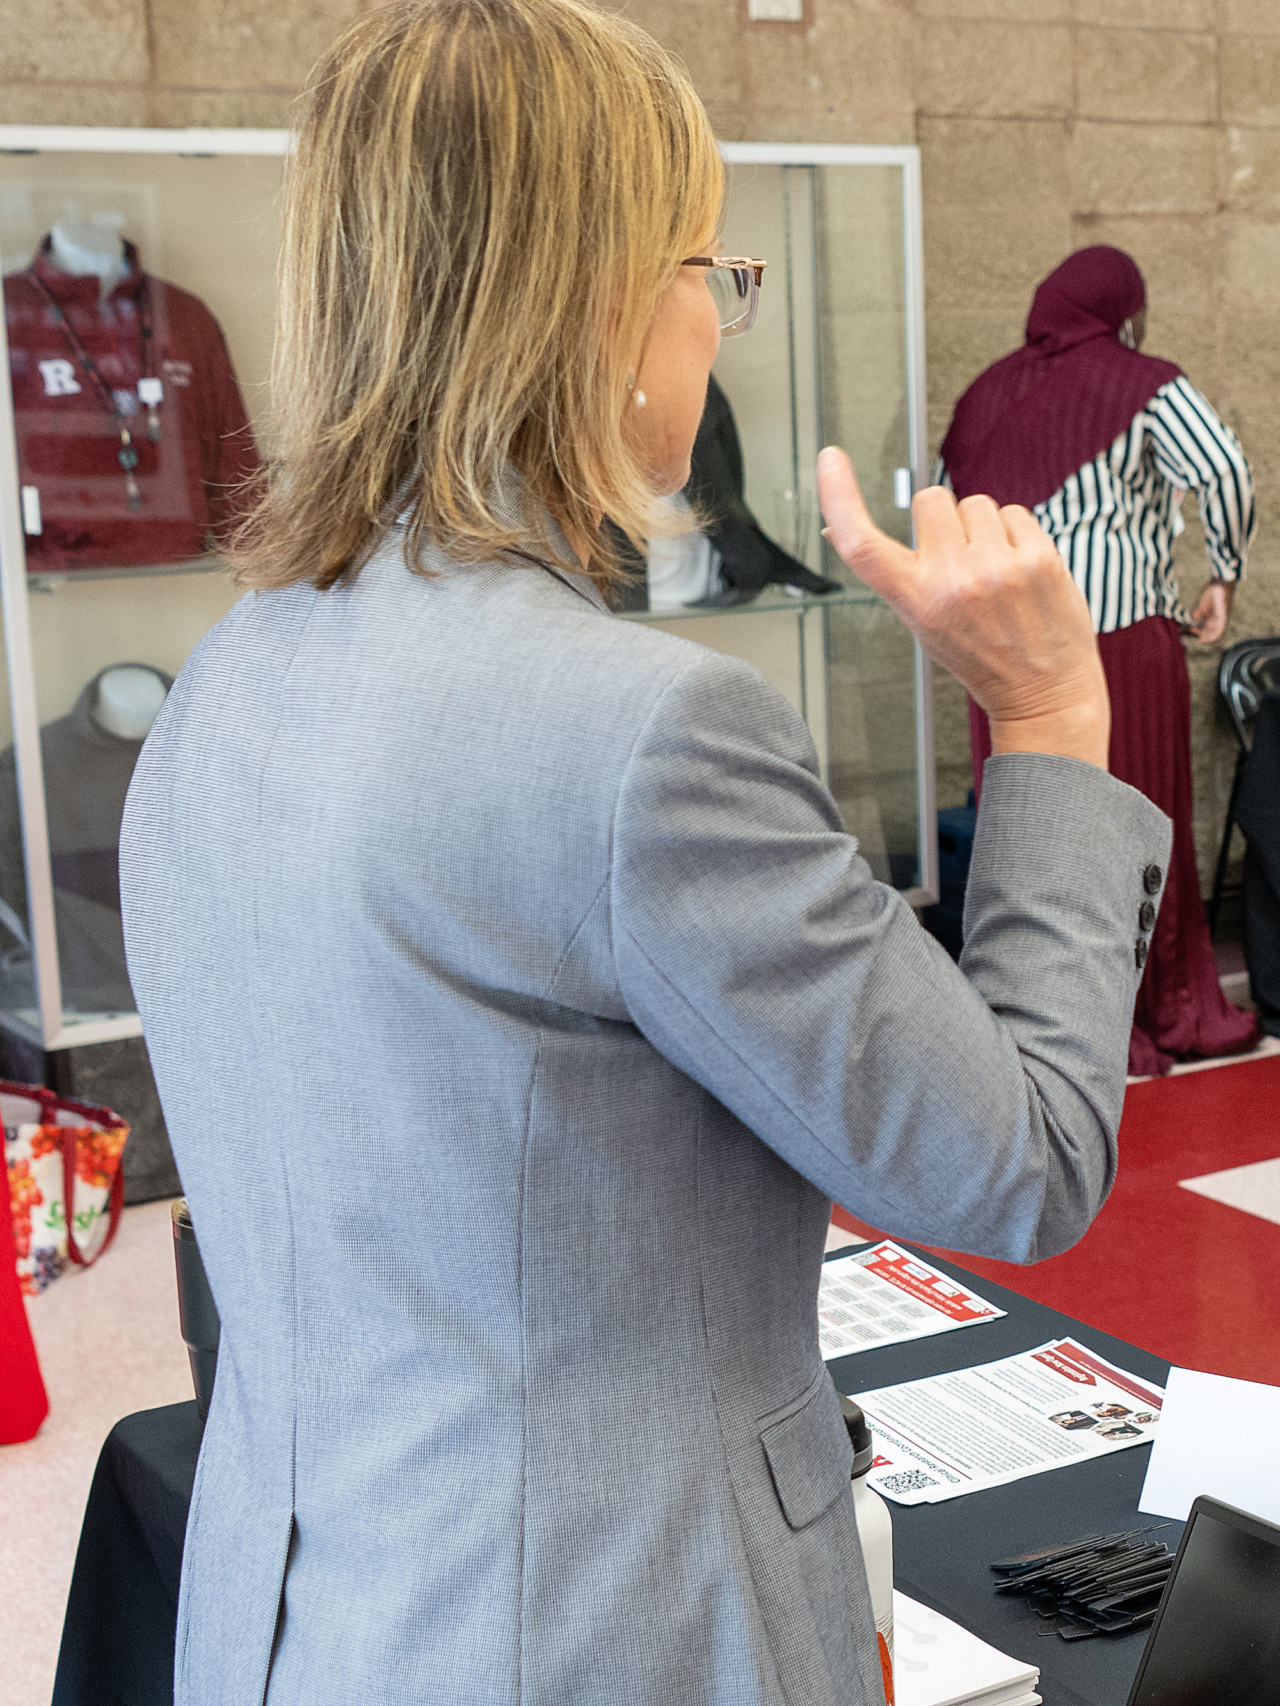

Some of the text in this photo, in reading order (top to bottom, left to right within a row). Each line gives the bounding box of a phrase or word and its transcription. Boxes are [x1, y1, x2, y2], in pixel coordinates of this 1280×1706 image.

[38, 358, 82, 397] R
[908, 1451, 938, 1470] Research
[932, 1467, 961, 1484] Clinical
